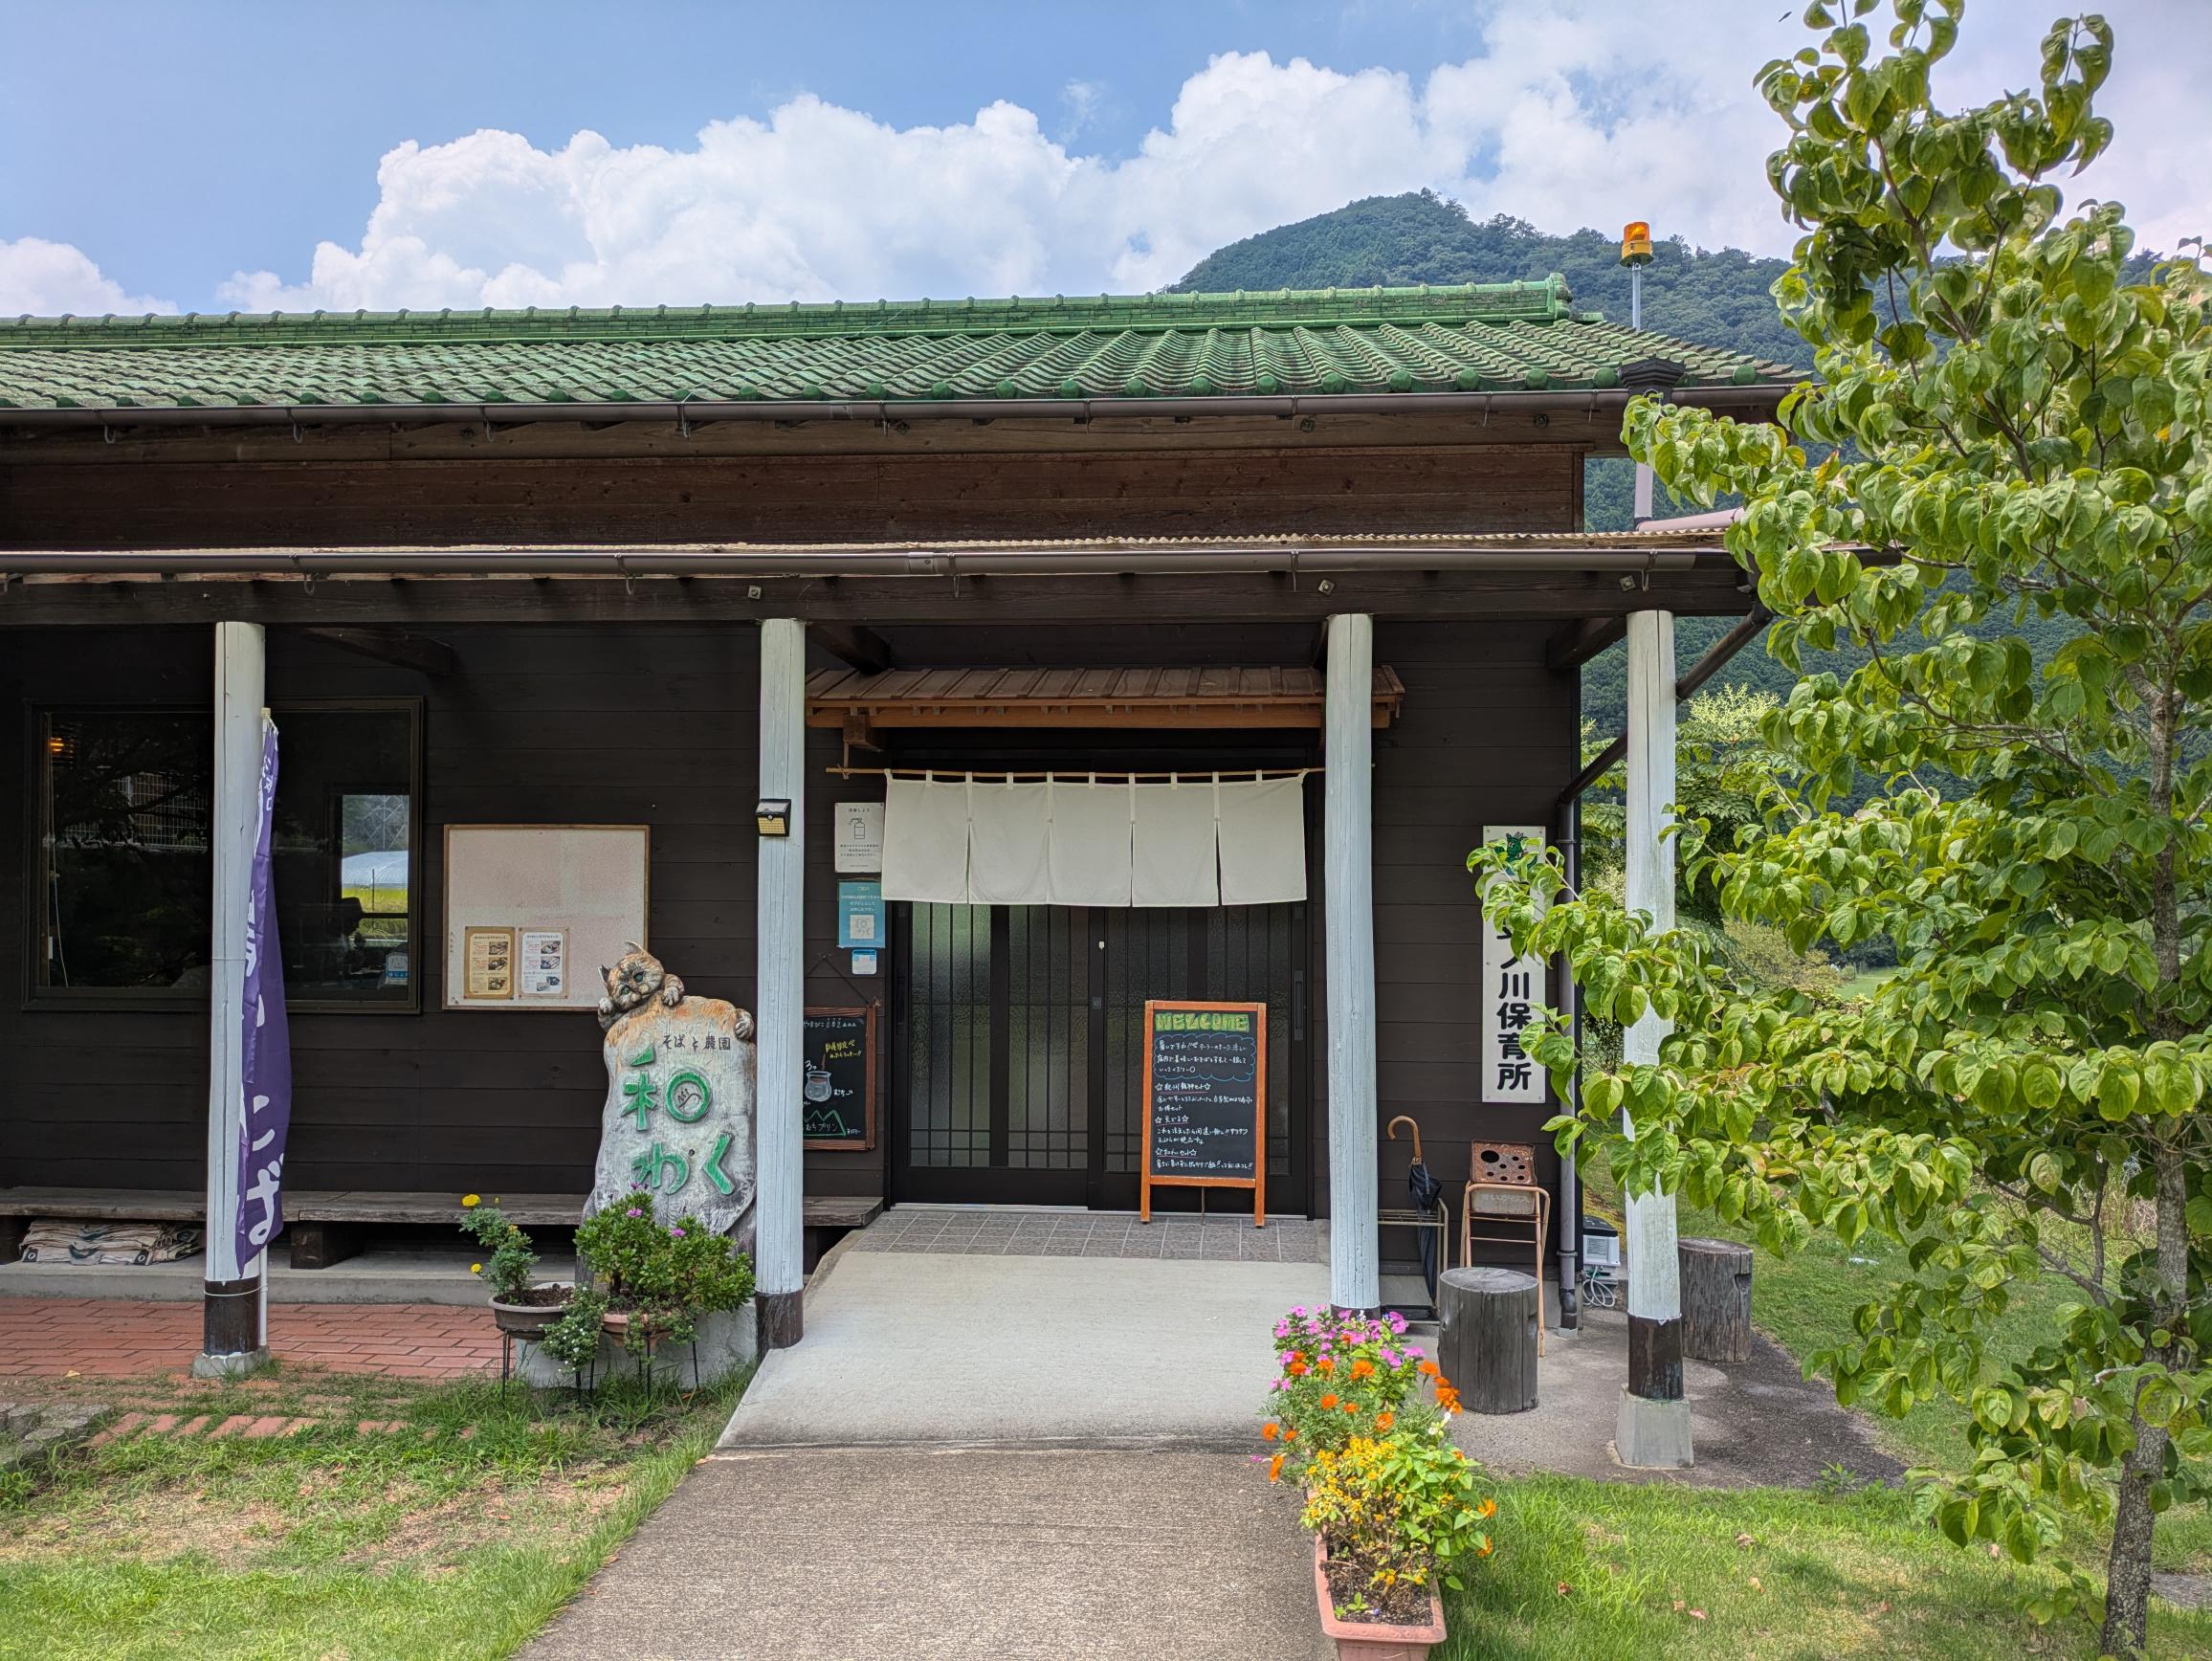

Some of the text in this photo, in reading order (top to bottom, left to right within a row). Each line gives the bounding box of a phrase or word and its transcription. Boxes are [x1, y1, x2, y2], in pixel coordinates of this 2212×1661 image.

[1155, 1012, 1250, 1032] WELCOME
[662, 1034, 731, 1051] そばと農園
[630, 1131, 736, 1196] わく
